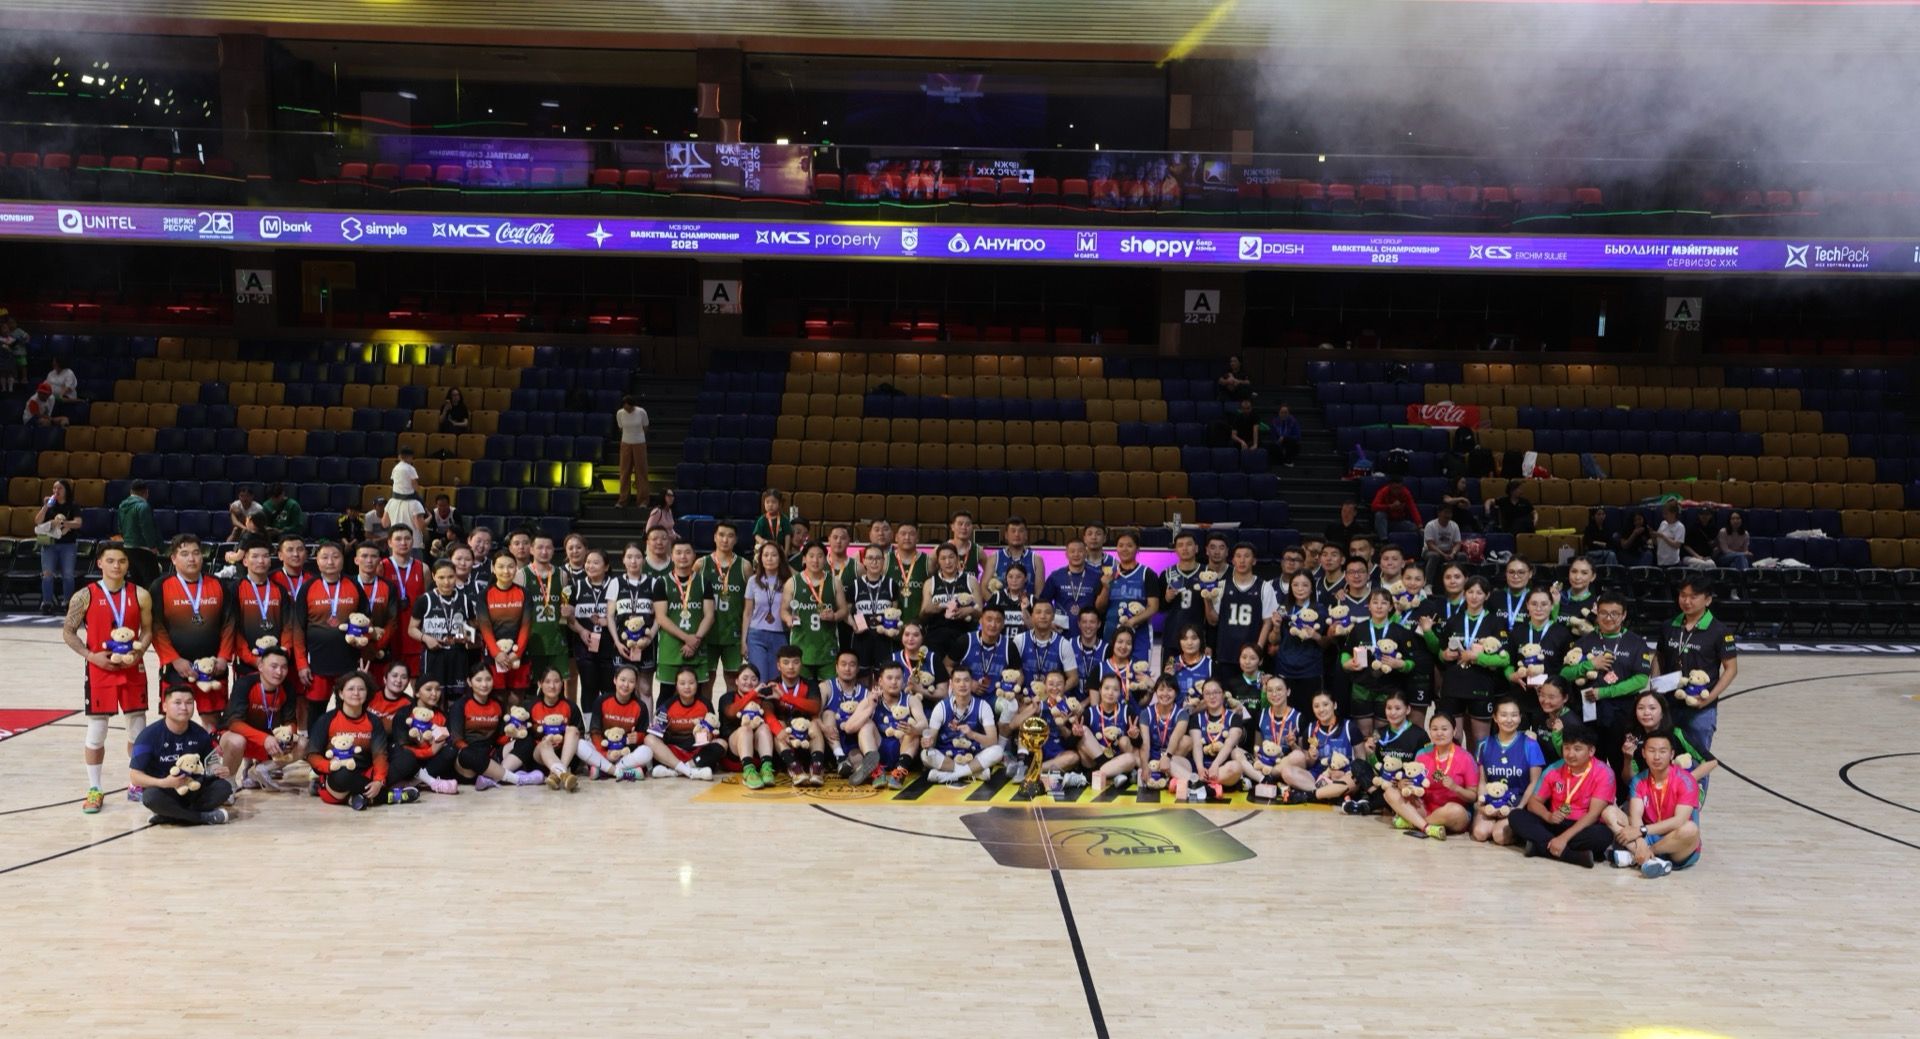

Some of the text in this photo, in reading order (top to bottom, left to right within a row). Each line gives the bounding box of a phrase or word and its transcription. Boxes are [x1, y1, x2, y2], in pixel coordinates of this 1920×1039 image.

[84, 215, 136, 230] UNITEL
[163, 217, 197, 226] ЭНЕРЖИ
[282, 220, 312, 233] bank
[163, 224, 194, 233] РЕСУРС
[366, 221, 408, 239] simple
[449, 223, 490, 238] MCS
[630, 230, 740, 241] BASKETBALL CHAMPIONSHIP
[771, 230, 881, 250] MCS property
[671, 240, 699, 250] 2025
[1120, 235, 1194, 258] shoppy
[1263, 243, 1304, 255] DDISH
[1331, 244, 1440, 254] BASKETBALL CHAMPIONSHIP
[1605, 243, 1739, 256] БЬЮЛДИНГ МЭЙНТЭНЭНС
[1371, 254, 1399, 263] 2025
[1485, 246, 1512, 260] ES
[1815, 245, 1870, 262] TechPack
[1667, 258, 1738, 268] СЕРВИСЭС ХХК
[245, 272, 263, 291] A
[712, 283, 730, 301] A
[1193, 292, 1211, 311] A
[1674, 300, 1692, 318] A
[1185, 314, 1217, 324] 22-41
[1666, 321, 1700, 331] 42-62
[1228, 603, 1252, 625] 16
[810, 614, 821, 631] 9
[1416, 690, 1424, 702] 3
[1487, 702, 1494, 713] 6
[159, 753, 180, 763] MCS
[1487, 765, 1523, 778] simple
[1103, 844, 1181, 860] MBA
